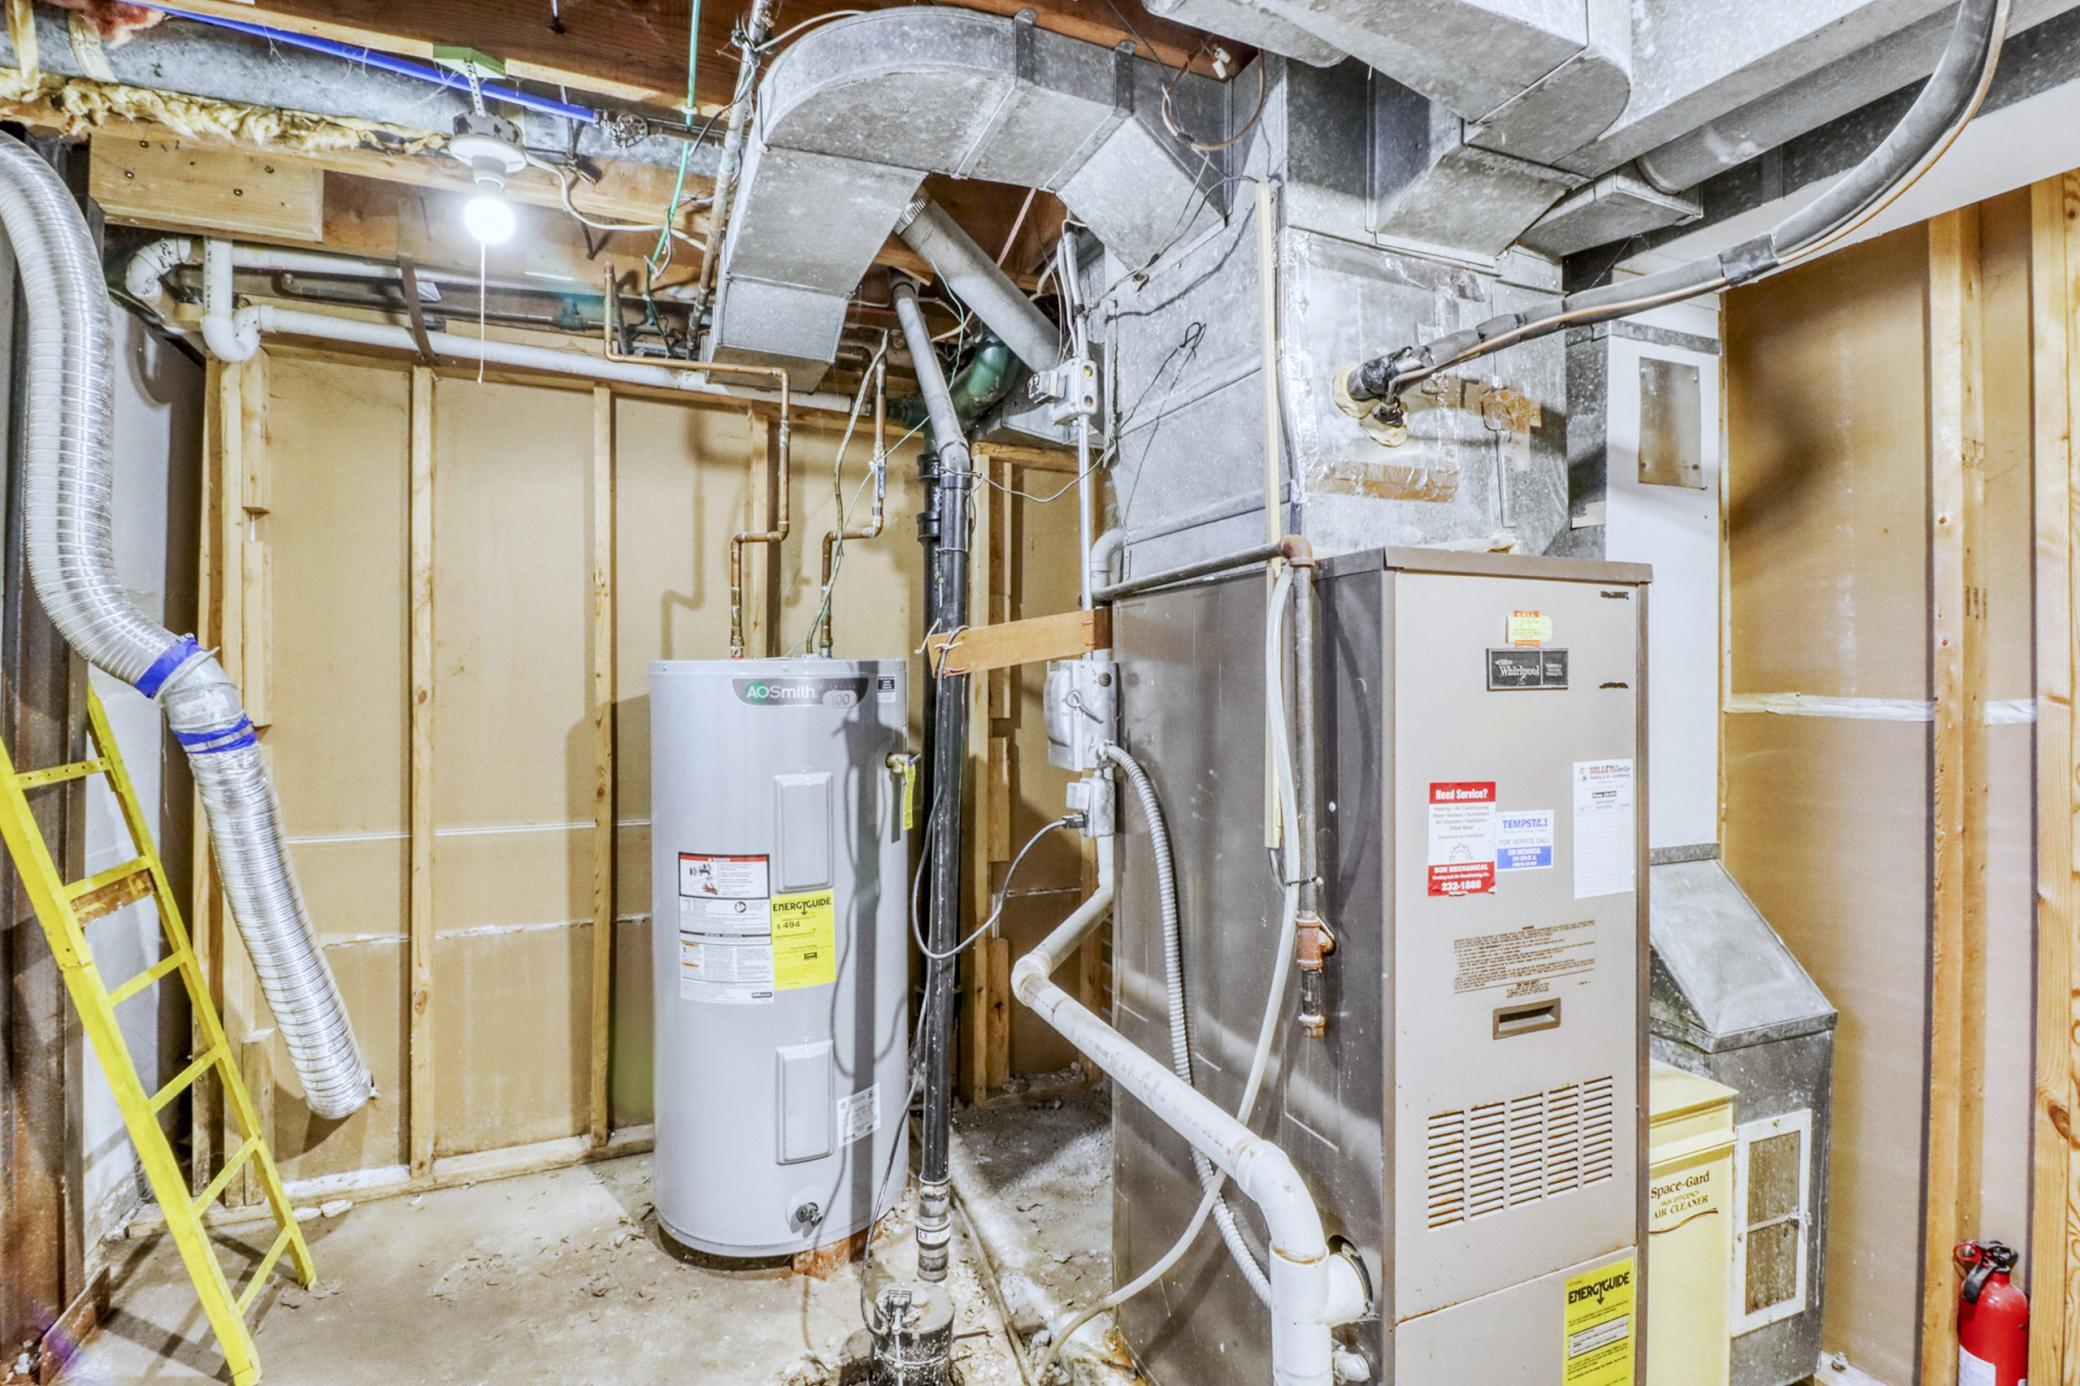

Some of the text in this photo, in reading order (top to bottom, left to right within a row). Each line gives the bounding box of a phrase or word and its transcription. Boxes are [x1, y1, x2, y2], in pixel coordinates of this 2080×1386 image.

[1499, 665, 1540, 681] Whirlpool
[1435, 788, 1488, 800] Need Service?
[783, 920, 801, 929] 494
[1650, 1170, 1710, 1199] Space-Gard
[1653, 1195, 1708, 1220] AIR CLEANER
